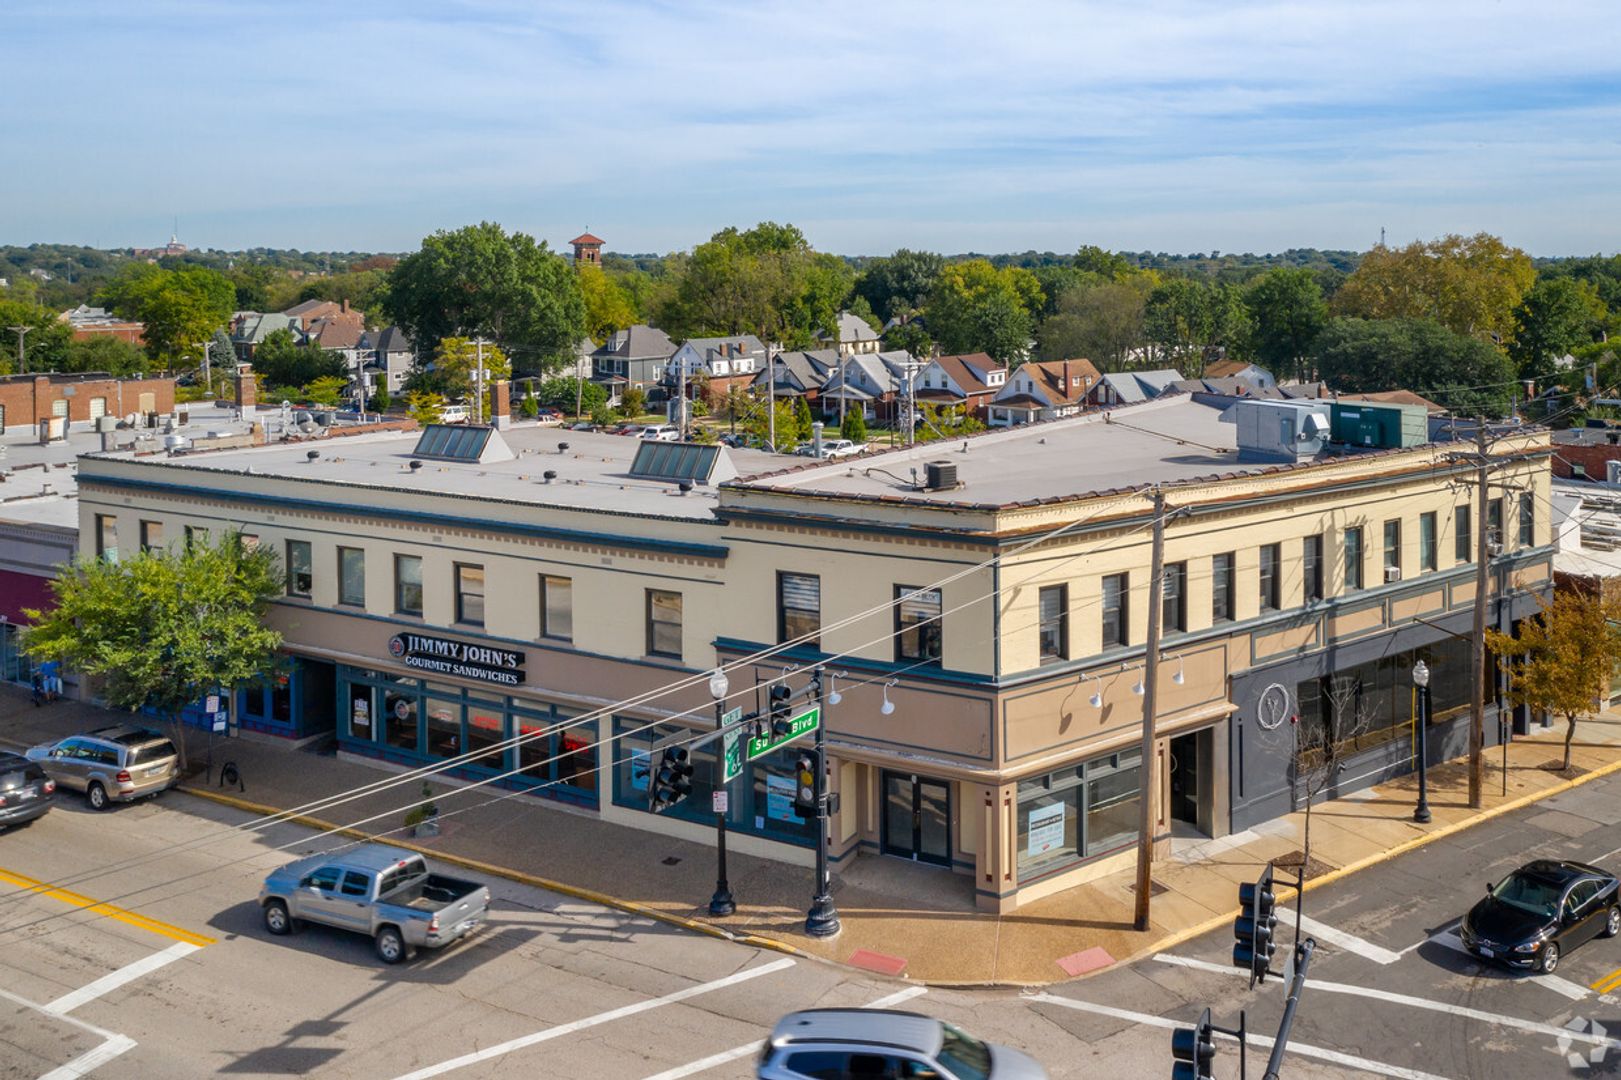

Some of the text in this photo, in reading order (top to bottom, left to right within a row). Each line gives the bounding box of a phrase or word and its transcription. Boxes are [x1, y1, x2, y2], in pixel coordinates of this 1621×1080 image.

[408, 635, 517, 668] JIMMY JOHN'S
[405, 655, 518, 685] GOURMET SANDWICHES
[792, 715, 813, 734] Blvd
